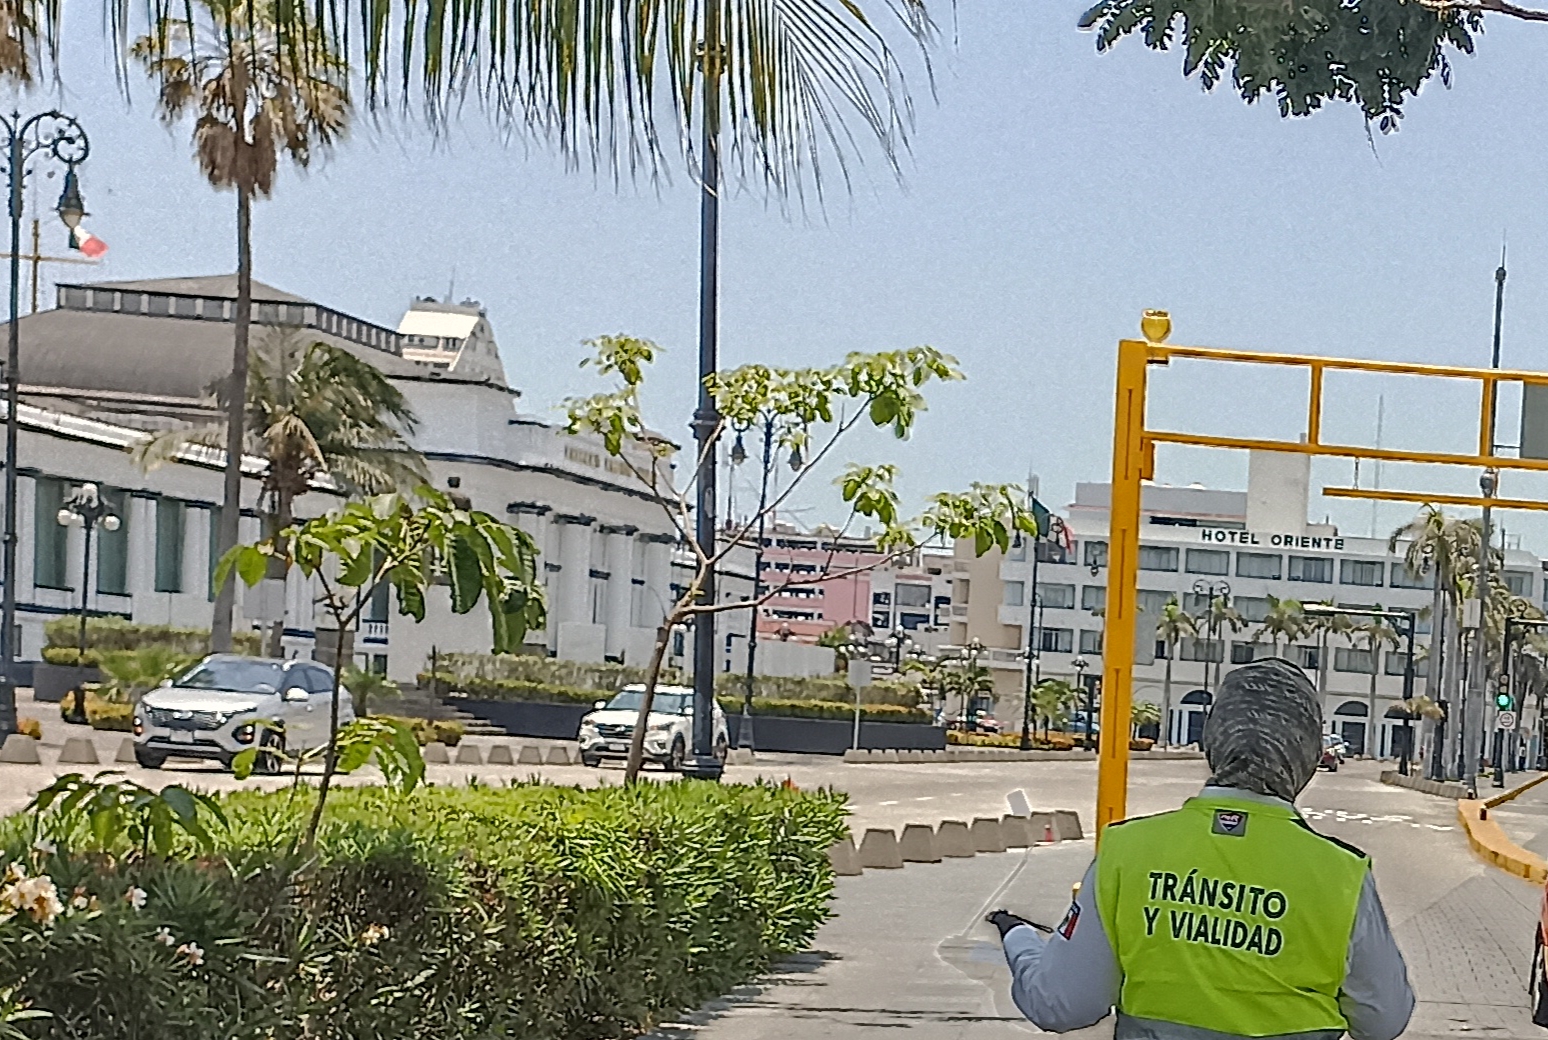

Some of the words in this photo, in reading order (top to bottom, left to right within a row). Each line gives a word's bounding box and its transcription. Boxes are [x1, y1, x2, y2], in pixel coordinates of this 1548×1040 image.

[1201, 529, 1260, 545] HOTEL
[1270, 534, 1345, 551] ORIENTE
[1148, 868, 1287, 920] TRÁNSITO
[1143, 906, 1161, 937] Y
[1169, 909, 1283, 957] VIALIDAD
